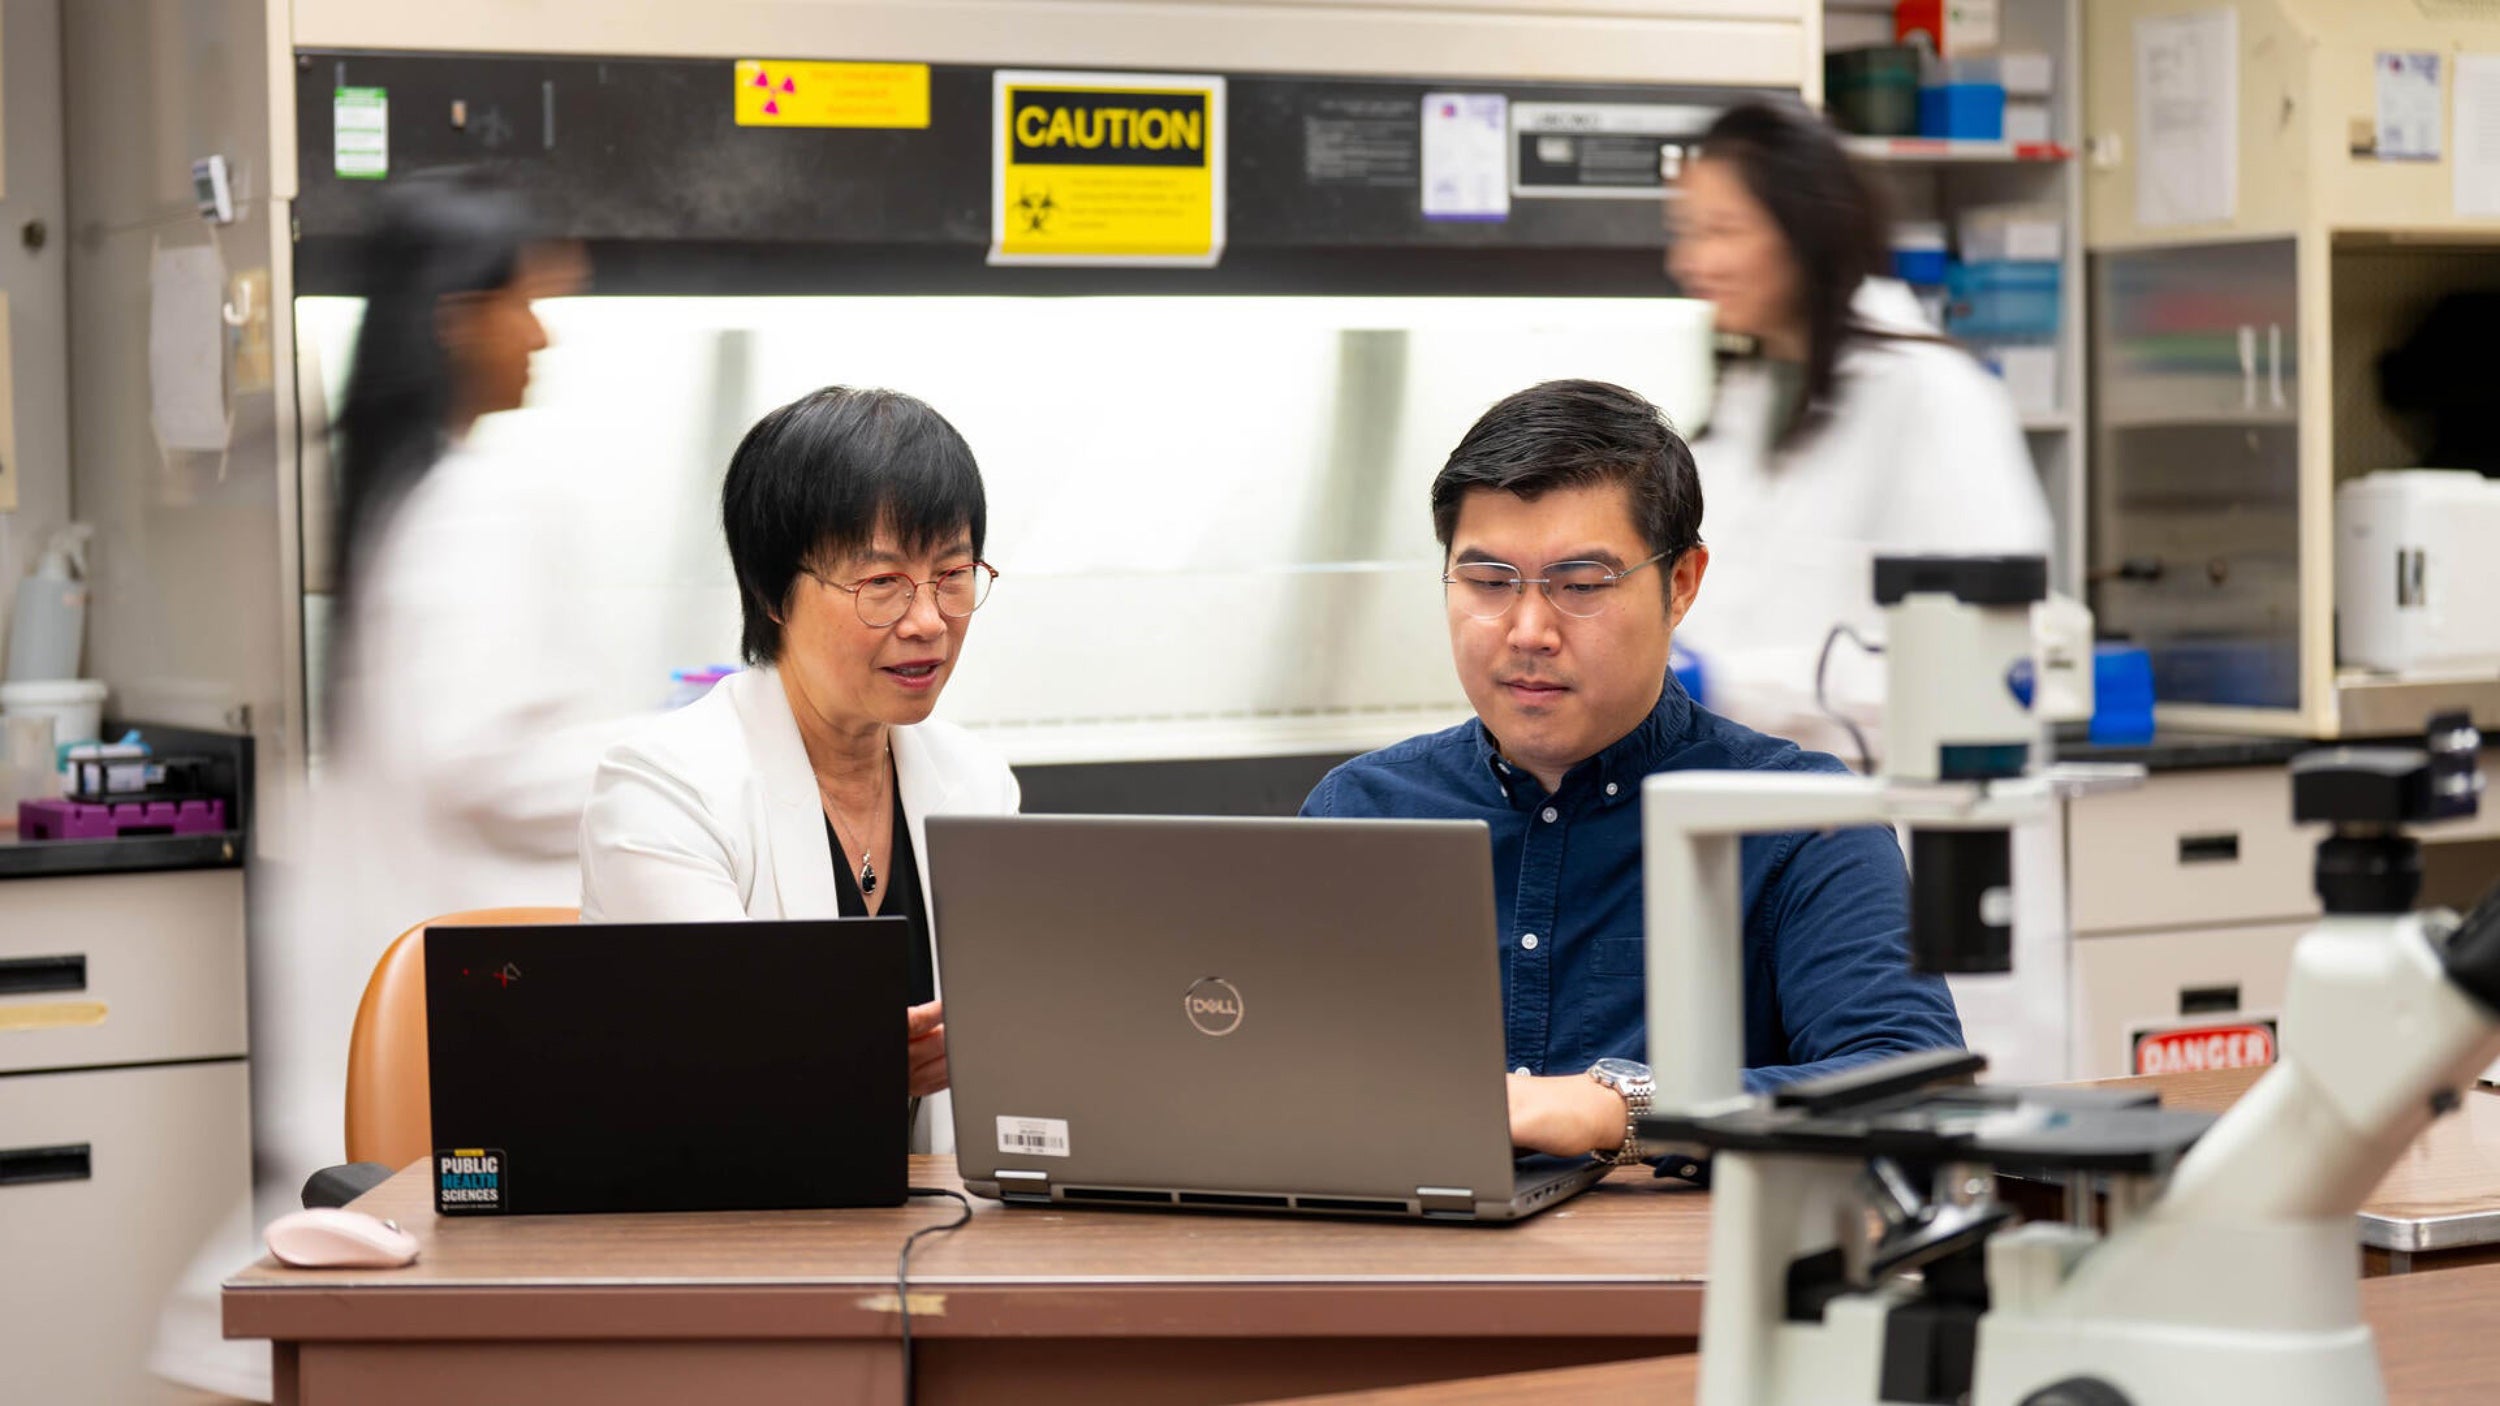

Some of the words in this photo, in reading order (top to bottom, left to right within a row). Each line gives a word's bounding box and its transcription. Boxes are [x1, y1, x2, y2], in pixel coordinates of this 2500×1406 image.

[1016, 105, 1200, 149] CAUTION
[1193, 998, 1238, 1014] DELL
[2143, 1033, 2266, 1075] DANGER
[441, 1156, 499, 1174] PUBLIC
[442, 1173, 498, 1189] HEALTH
[442, 1189, 499, 1202] SCIENCES
